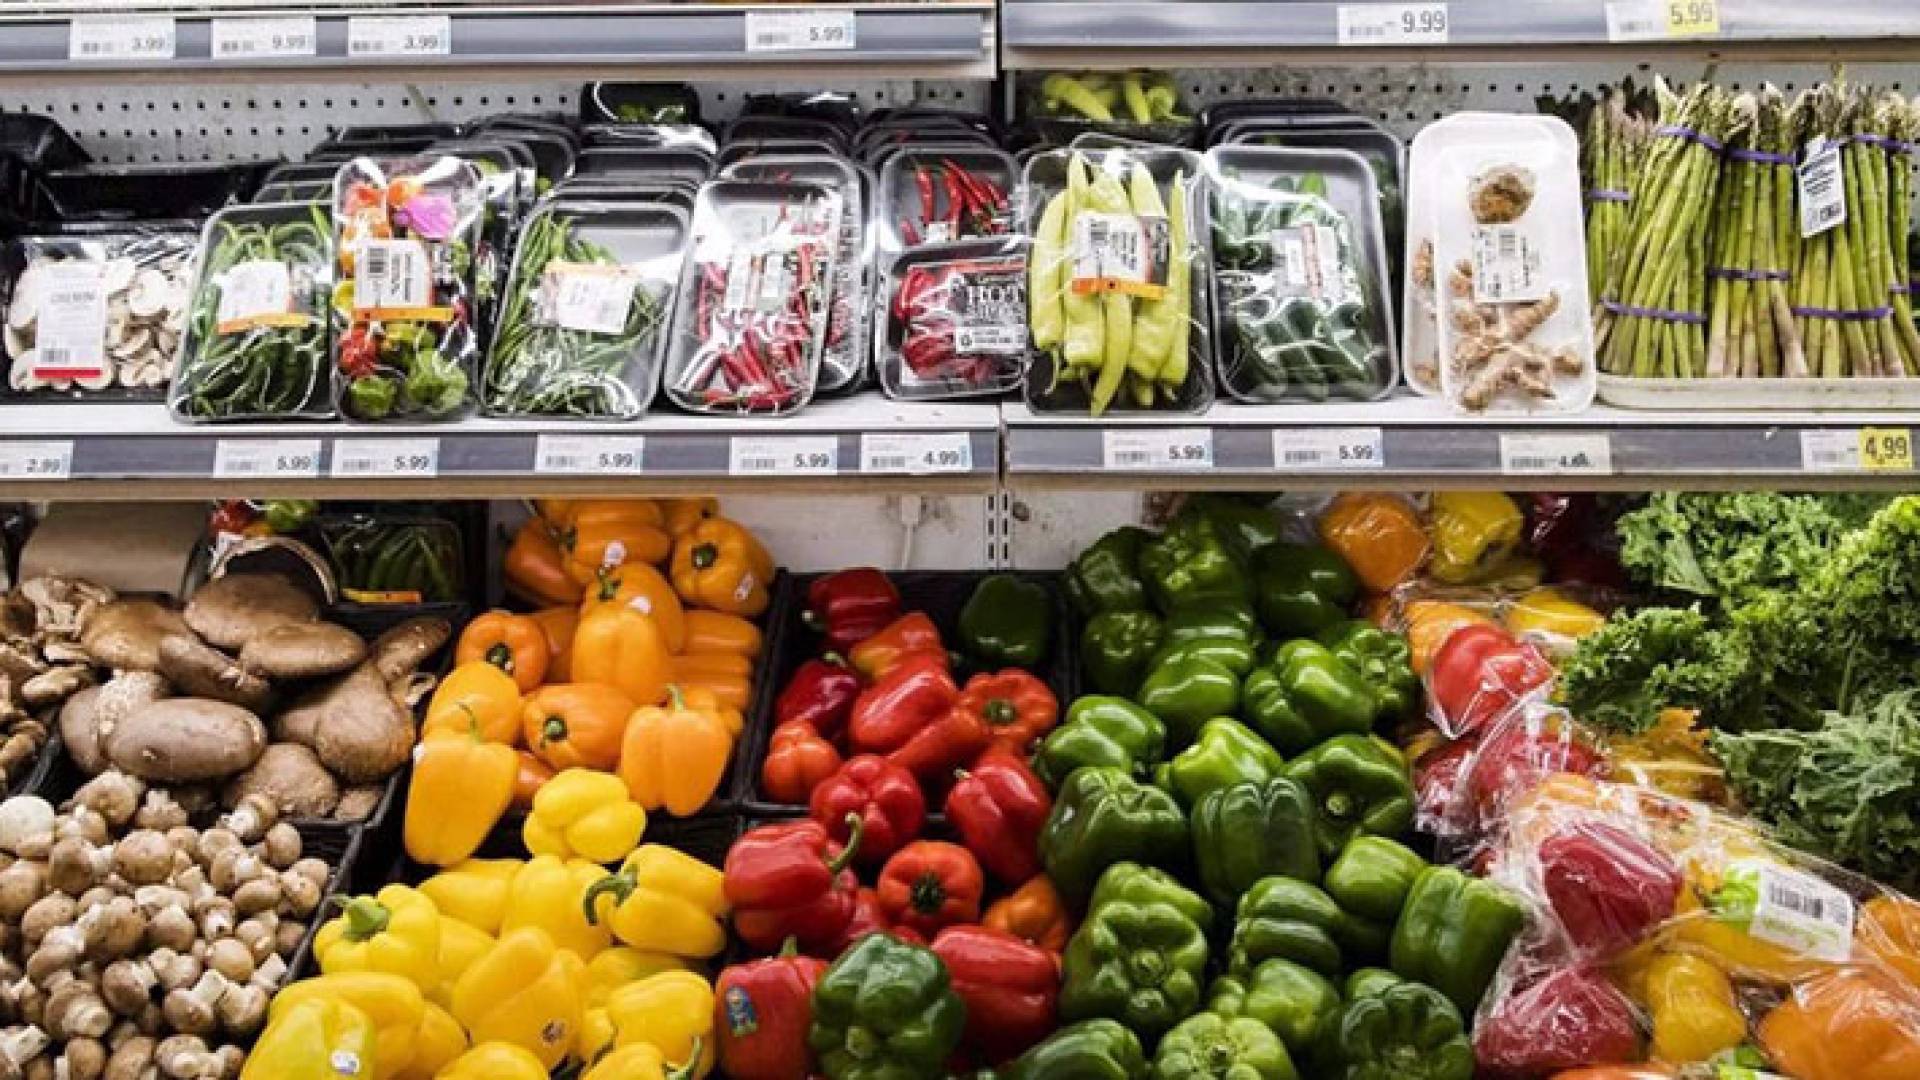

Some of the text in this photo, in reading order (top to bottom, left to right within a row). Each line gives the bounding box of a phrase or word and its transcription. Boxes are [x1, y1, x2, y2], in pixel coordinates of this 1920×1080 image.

[1670, 2, 1713, 25] 5.99
[1401, 10, 1446, 33] 9.99
[809, 27, 843, 41] 5.99
[923, 450, 959, 465] 4.99
[1168, 445, 1205, 460] 5.99
[1338, 444, 1373, 460] 5.99
[277, 455, 312, 471] 5.99
[394, 455, 430, 470] 5.99
[599, 453, 633, 468] 5.99
[794, 453, 830, 468] 5.99
